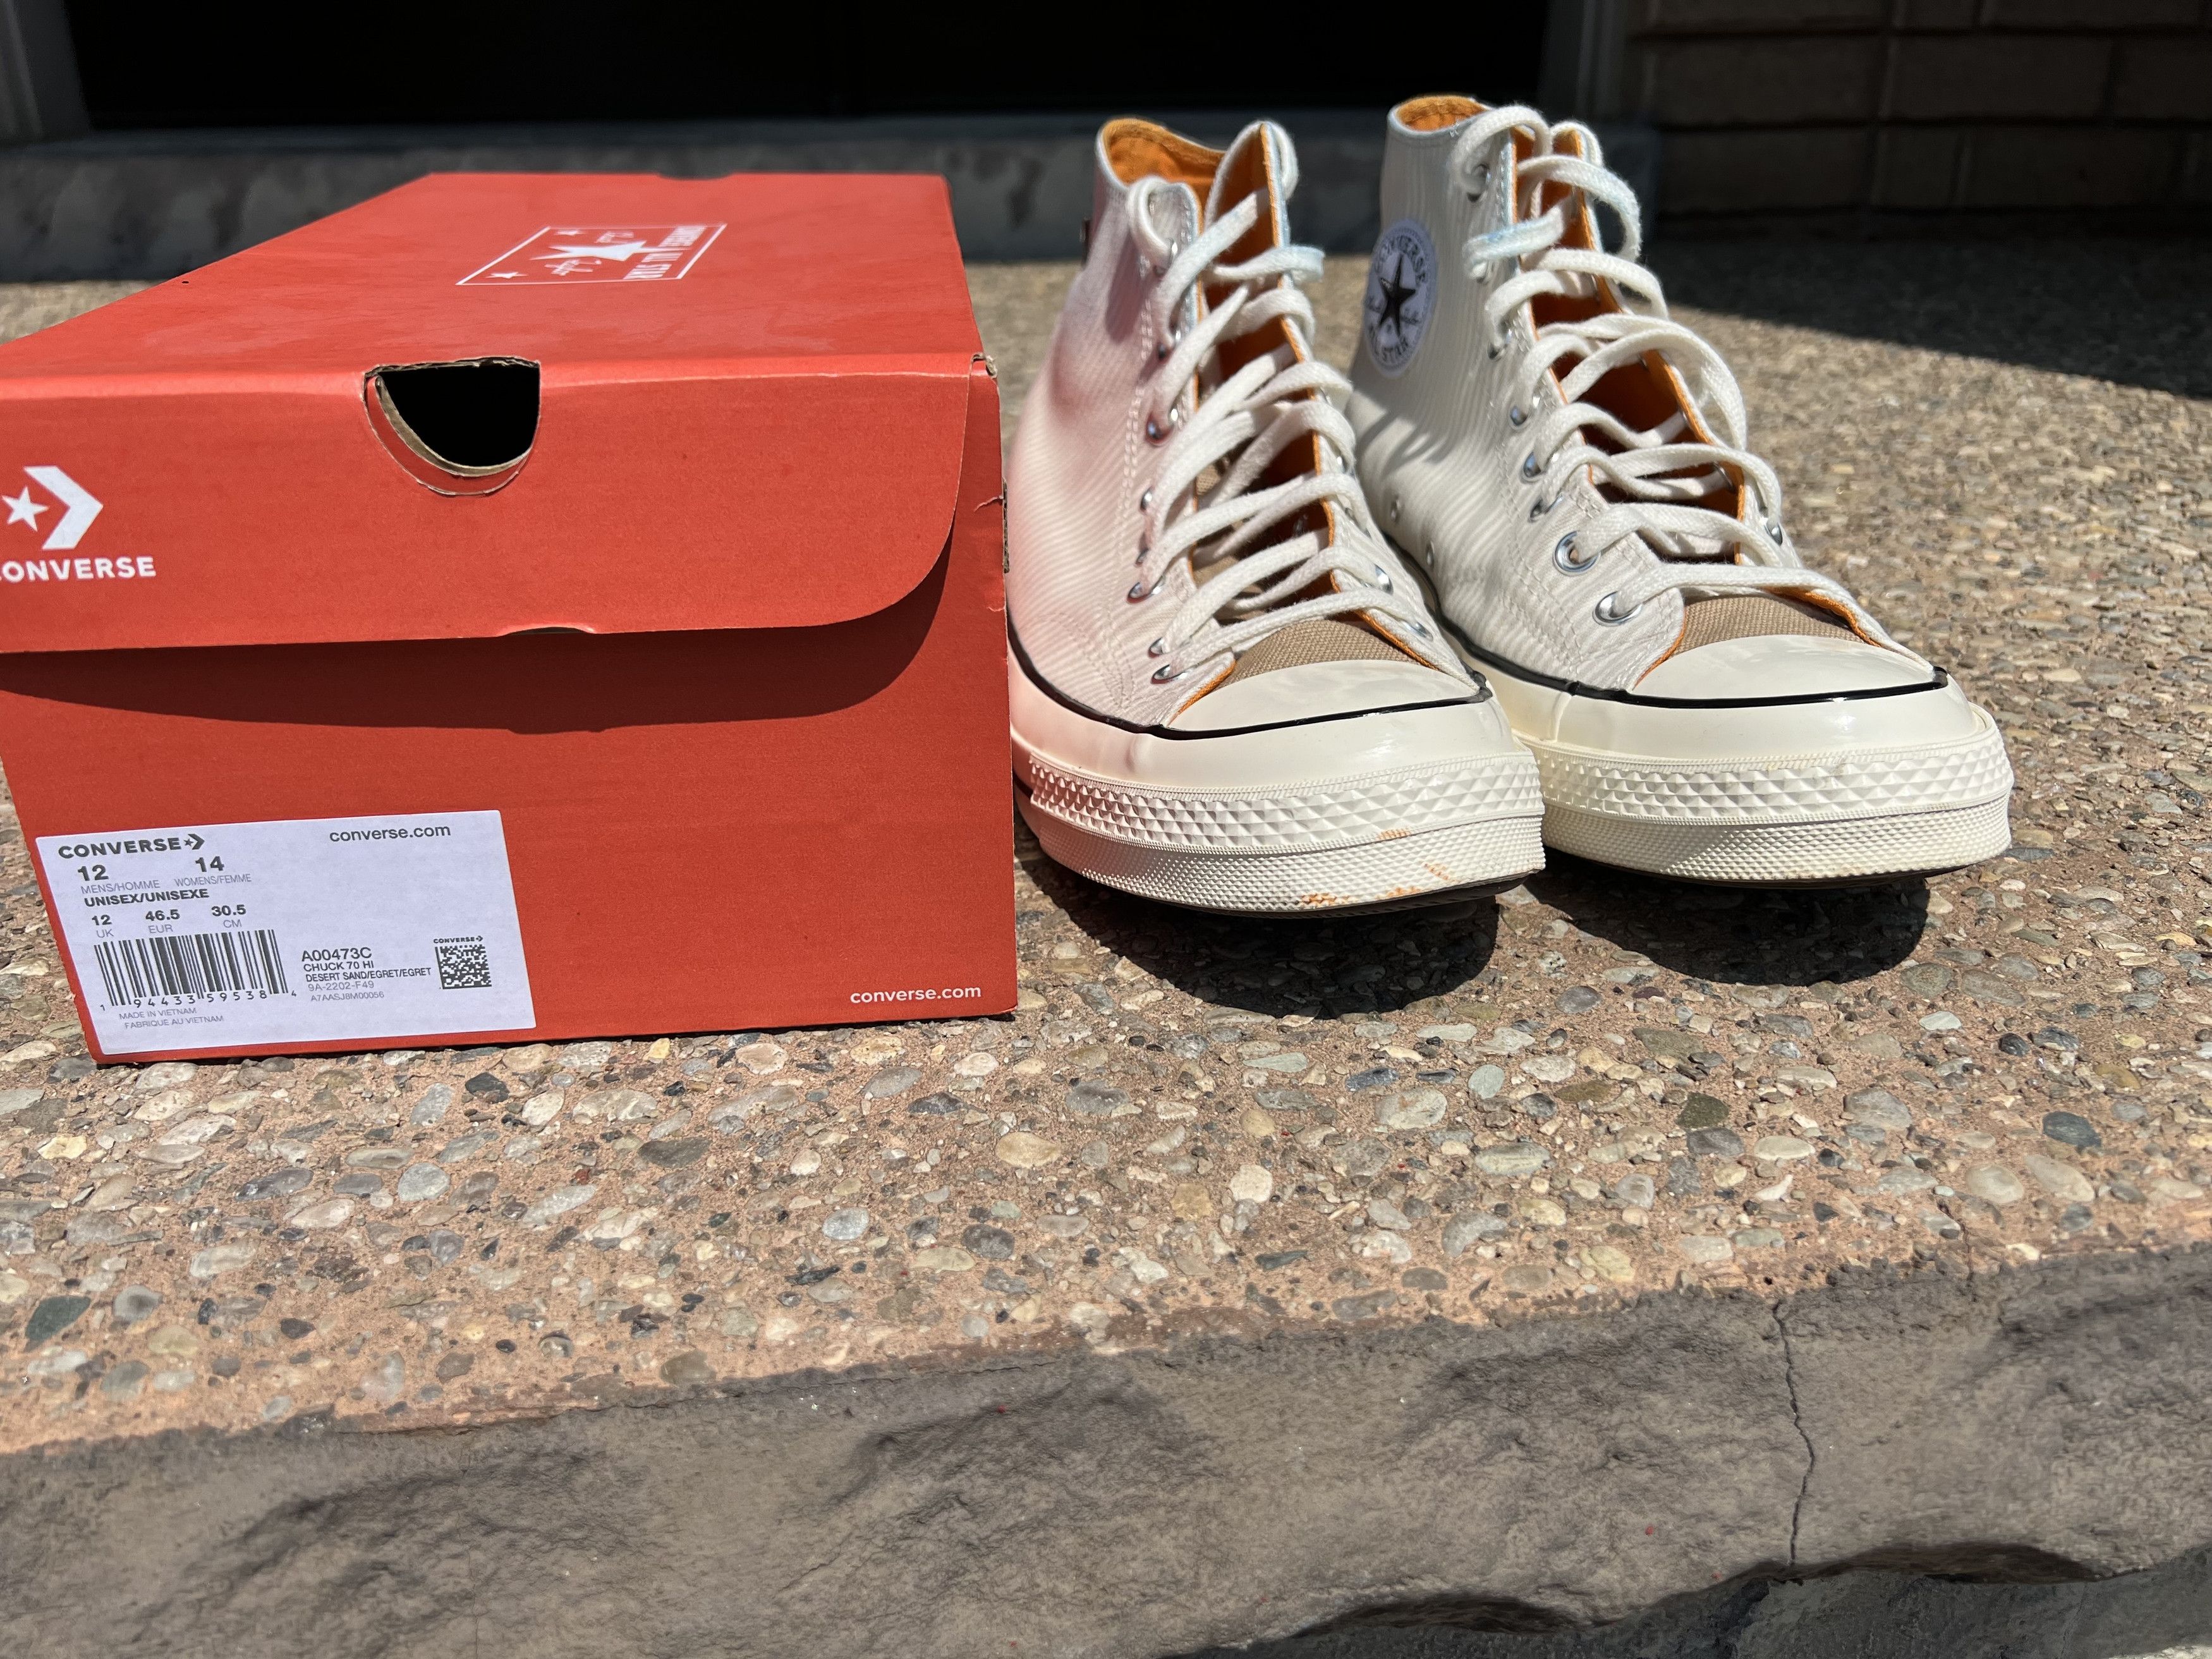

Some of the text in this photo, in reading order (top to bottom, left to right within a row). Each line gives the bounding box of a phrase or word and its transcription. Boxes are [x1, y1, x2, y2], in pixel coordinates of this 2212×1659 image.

[0, 556, 157, 583] ONVERSE
[329, 825, 451, 842] converse.com
[58, 837, 180, 858] CONVERSE
[195, 856, 225, 873] 14
[78, 864, 109, 882] 12
[174, 873, 252, 887] WOMENS/FEMME
[81, 880, 161, 894] MENS/HOMME
[84, 889, 210, 908] UNISEX/UNISEXE
[145, 909, 181, 922] 46.5
[211, 904, 247, 917] 30.5
[92, 914, 112, 927] 12
[223, 919, 243, 929] CM
[96, 928, 114, 939] UK
[148, 923, 174, 934] EUR
[301, 947, 372, 963] A00473C
[303, 960, 374, 972] CHUCK 70 HI
[306, 967, 432, 982] DESERT SAND/EGRET/EGRET
[850, 986, 981, 1004] converse.com
[119, 1011, 145, 1020] MADE
[158, 1007, 197, 1016] VIETNAM
[125, 1015, 224, 1029] FABRIQUE AU VIETNAM
